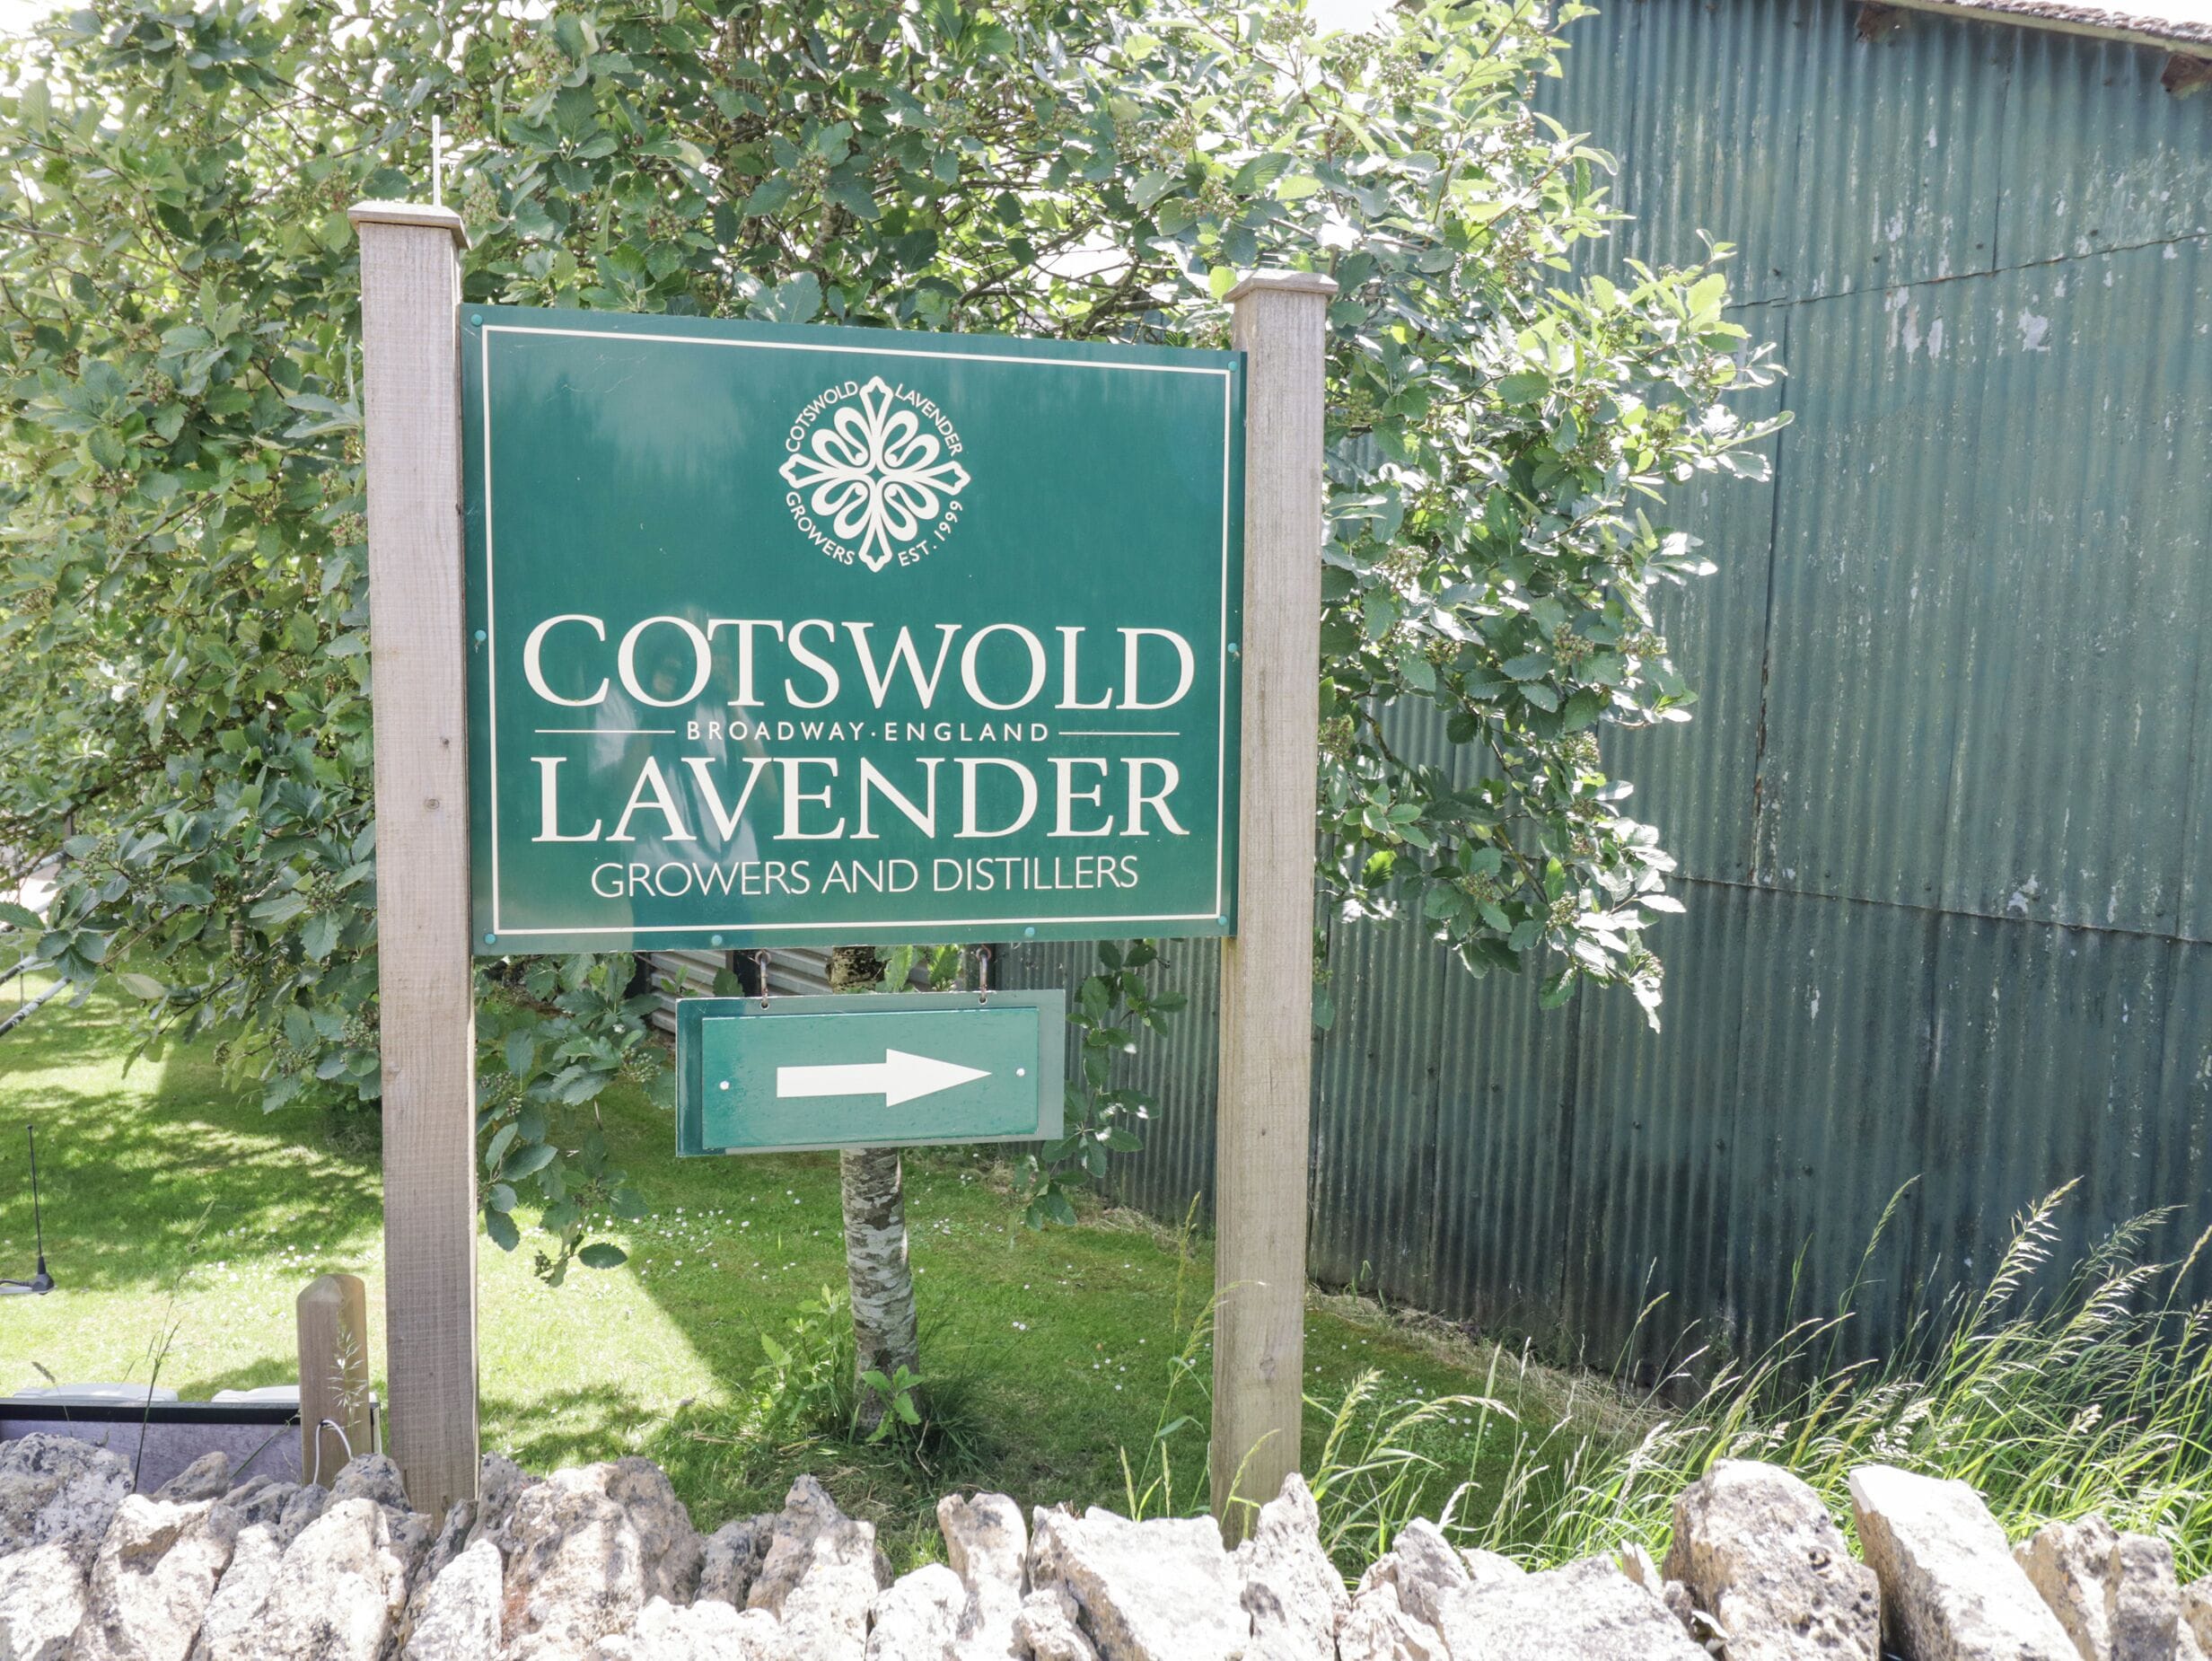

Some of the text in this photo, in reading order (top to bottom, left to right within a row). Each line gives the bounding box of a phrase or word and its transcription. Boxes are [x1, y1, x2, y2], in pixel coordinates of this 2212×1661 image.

[786, 381, 963, 457] COTSWOLD LAVENDER
[786, 491, 856, 566] GROWERS
[898, 500, 963, 567] EST. 1999
[523, 614, 1195, 710] COTSWOLD
[531, 756, 1189, 844] LAVENDER
[591, 855, 1139, 899] GROWERS AND DISTILLERS
